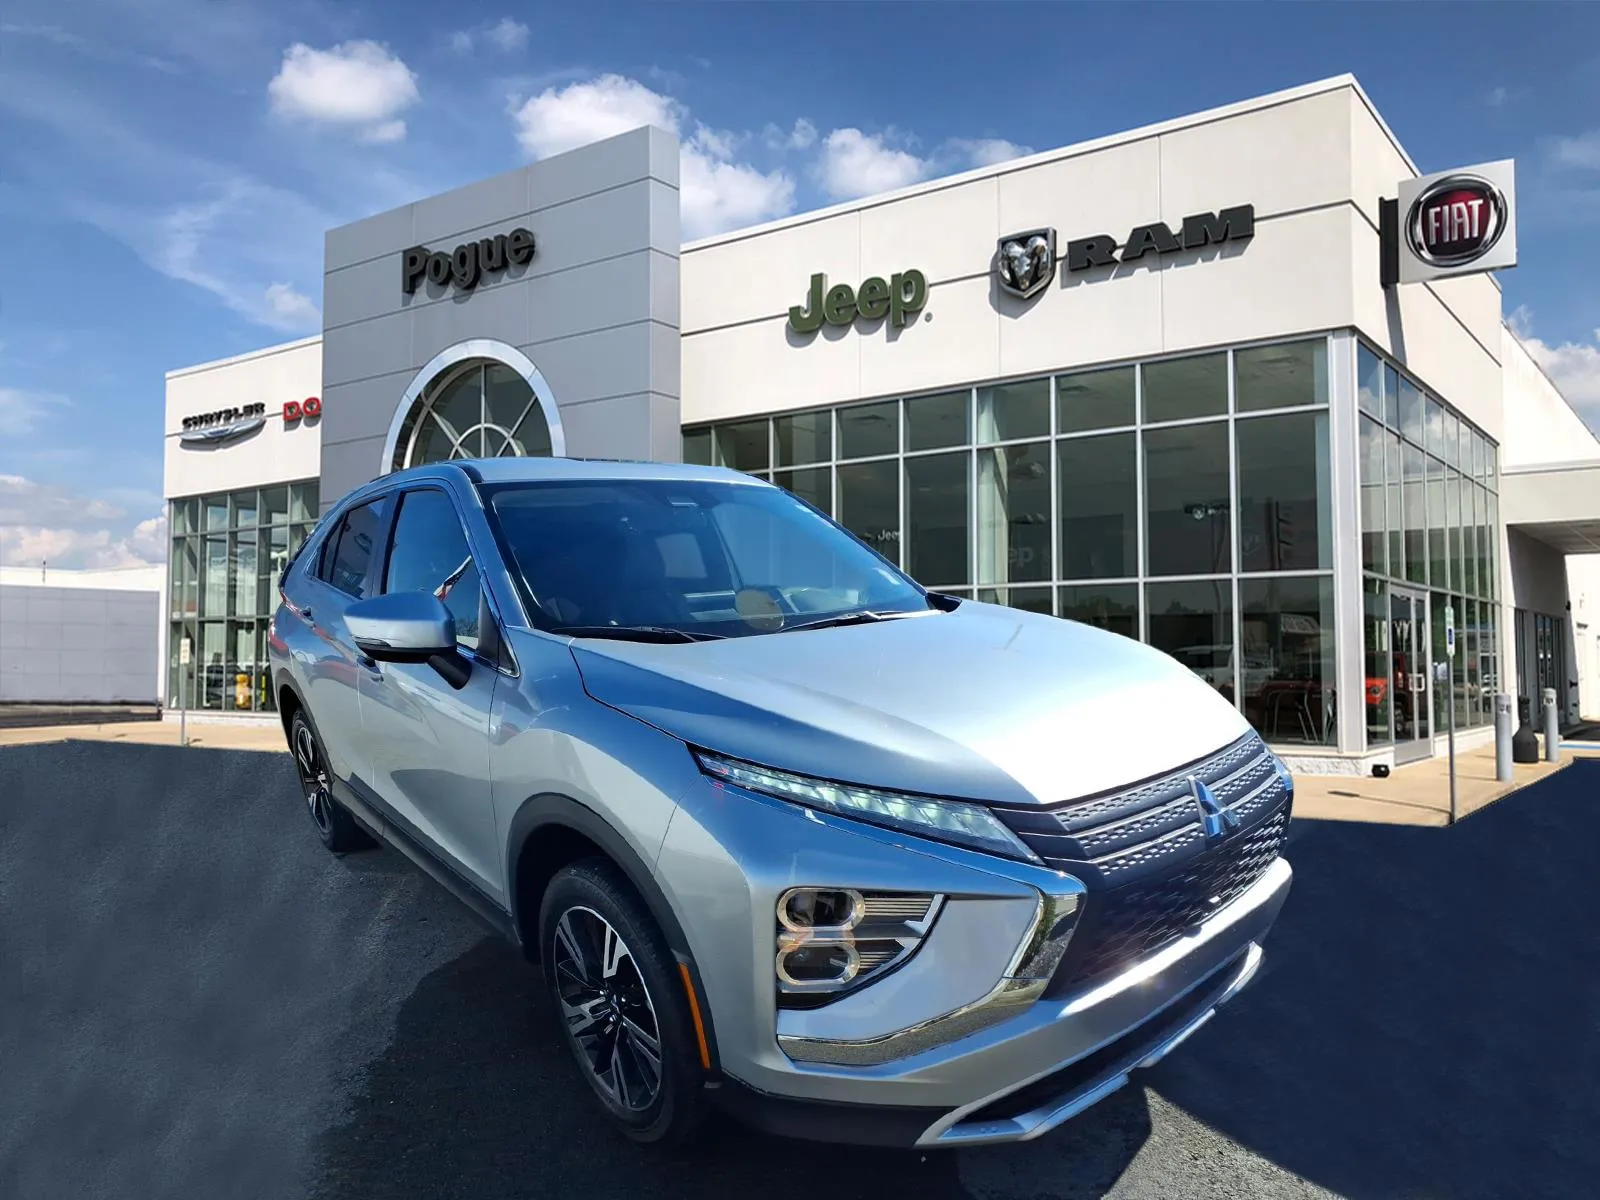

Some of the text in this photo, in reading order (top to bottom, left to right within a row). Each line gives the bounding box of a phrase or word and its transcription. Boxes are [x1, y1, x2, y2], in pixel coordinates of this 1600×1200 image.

[1067, 204, 1254, 271] RAM
[1428, 199, 1484, 245] FIAT
[402, 228, 535, 293] Pogue
[788, 268, 928, 332] Jeep
[182, 402, 266, 428] CHRYSLER
